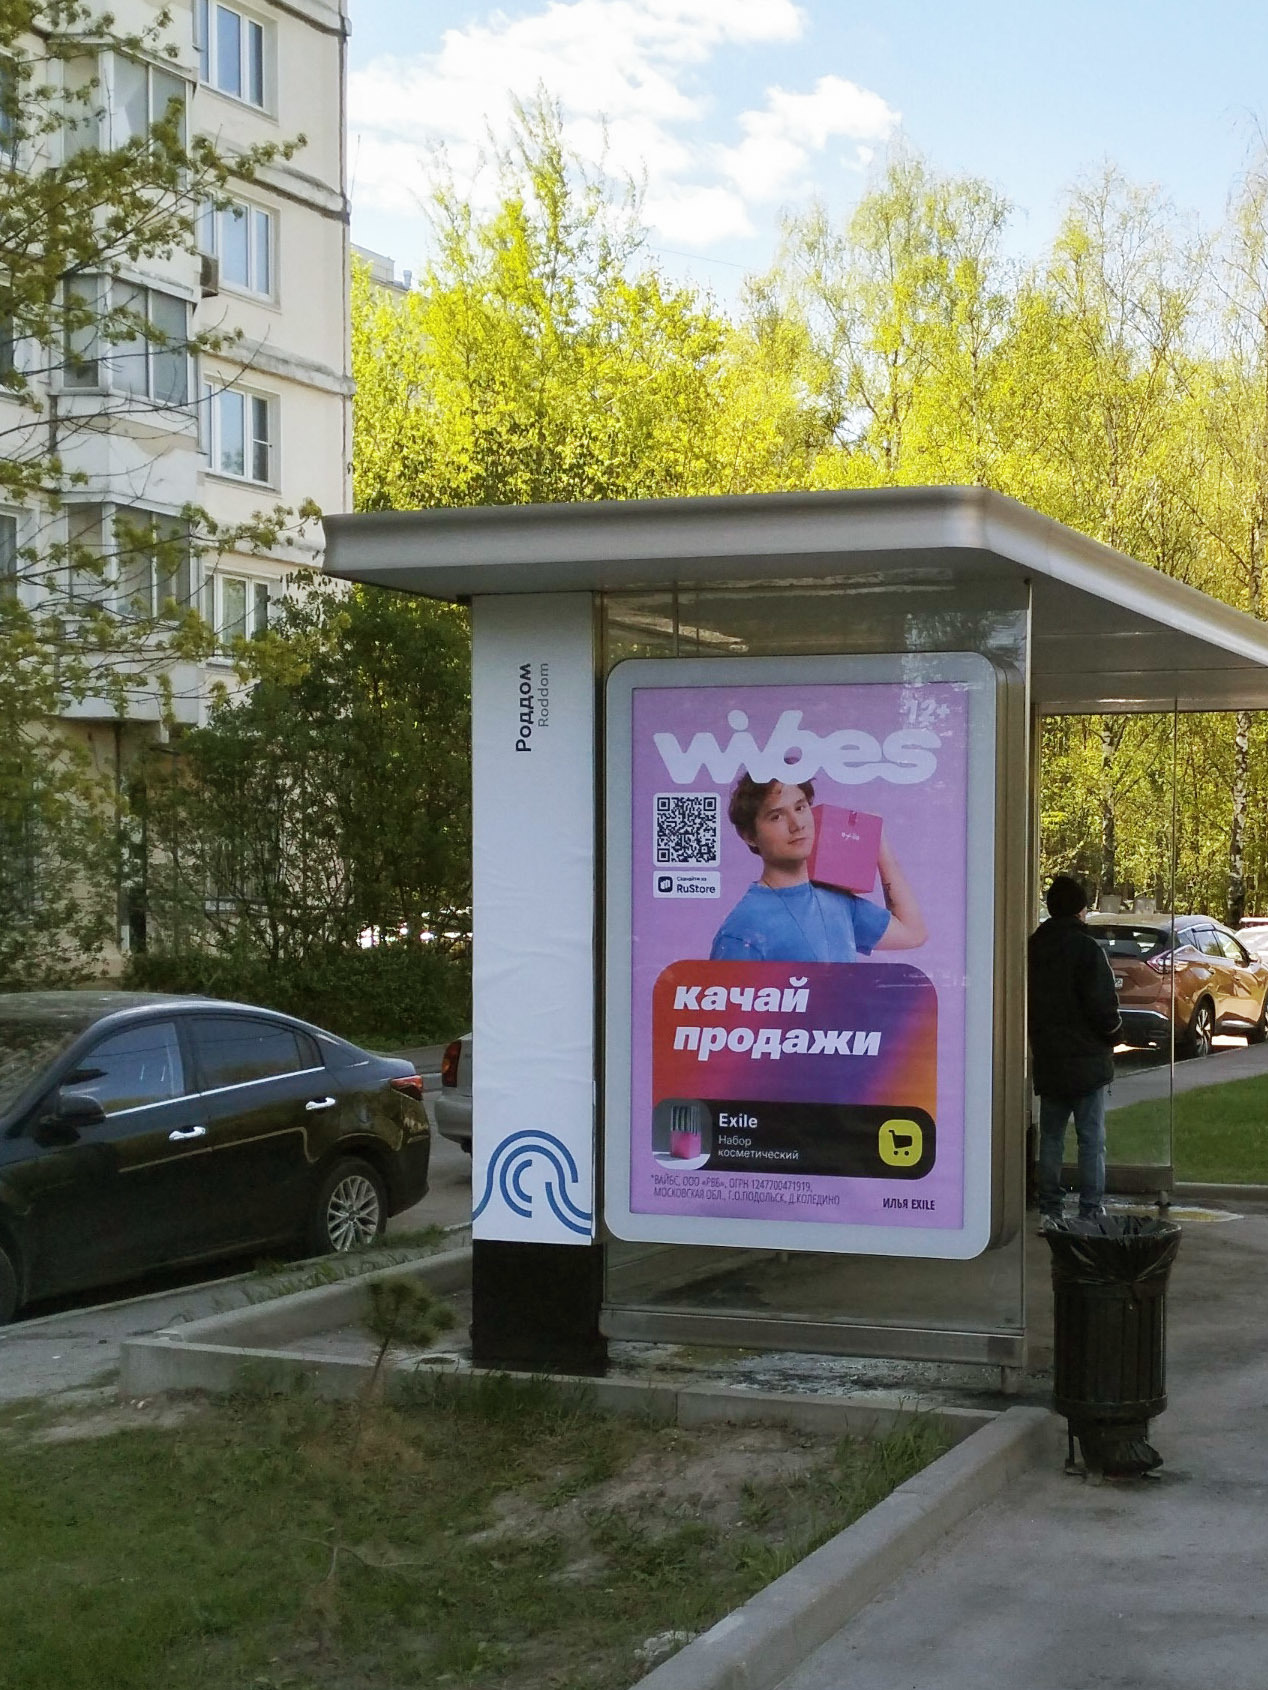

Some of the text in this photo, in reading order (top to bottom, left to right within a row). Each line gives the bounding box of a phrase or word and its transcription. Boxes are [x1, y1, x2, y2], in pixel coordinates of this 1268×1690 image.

[537, 663, 549, 727] Roddom
[515, 663, 534, 752] Роддом
[676, 884, 716, 894] RuStore
[673, 976, 810, 1013] качай
[673, 1026, 882, 1061] продажи
[719, 1113, 758, 1128] Exile
[718, 1135, 752, 1147] Набор
[718, 1149, 799, 1160] косметический
[883, 1198, 936, 1210] ИЛЬЯ EXILE
